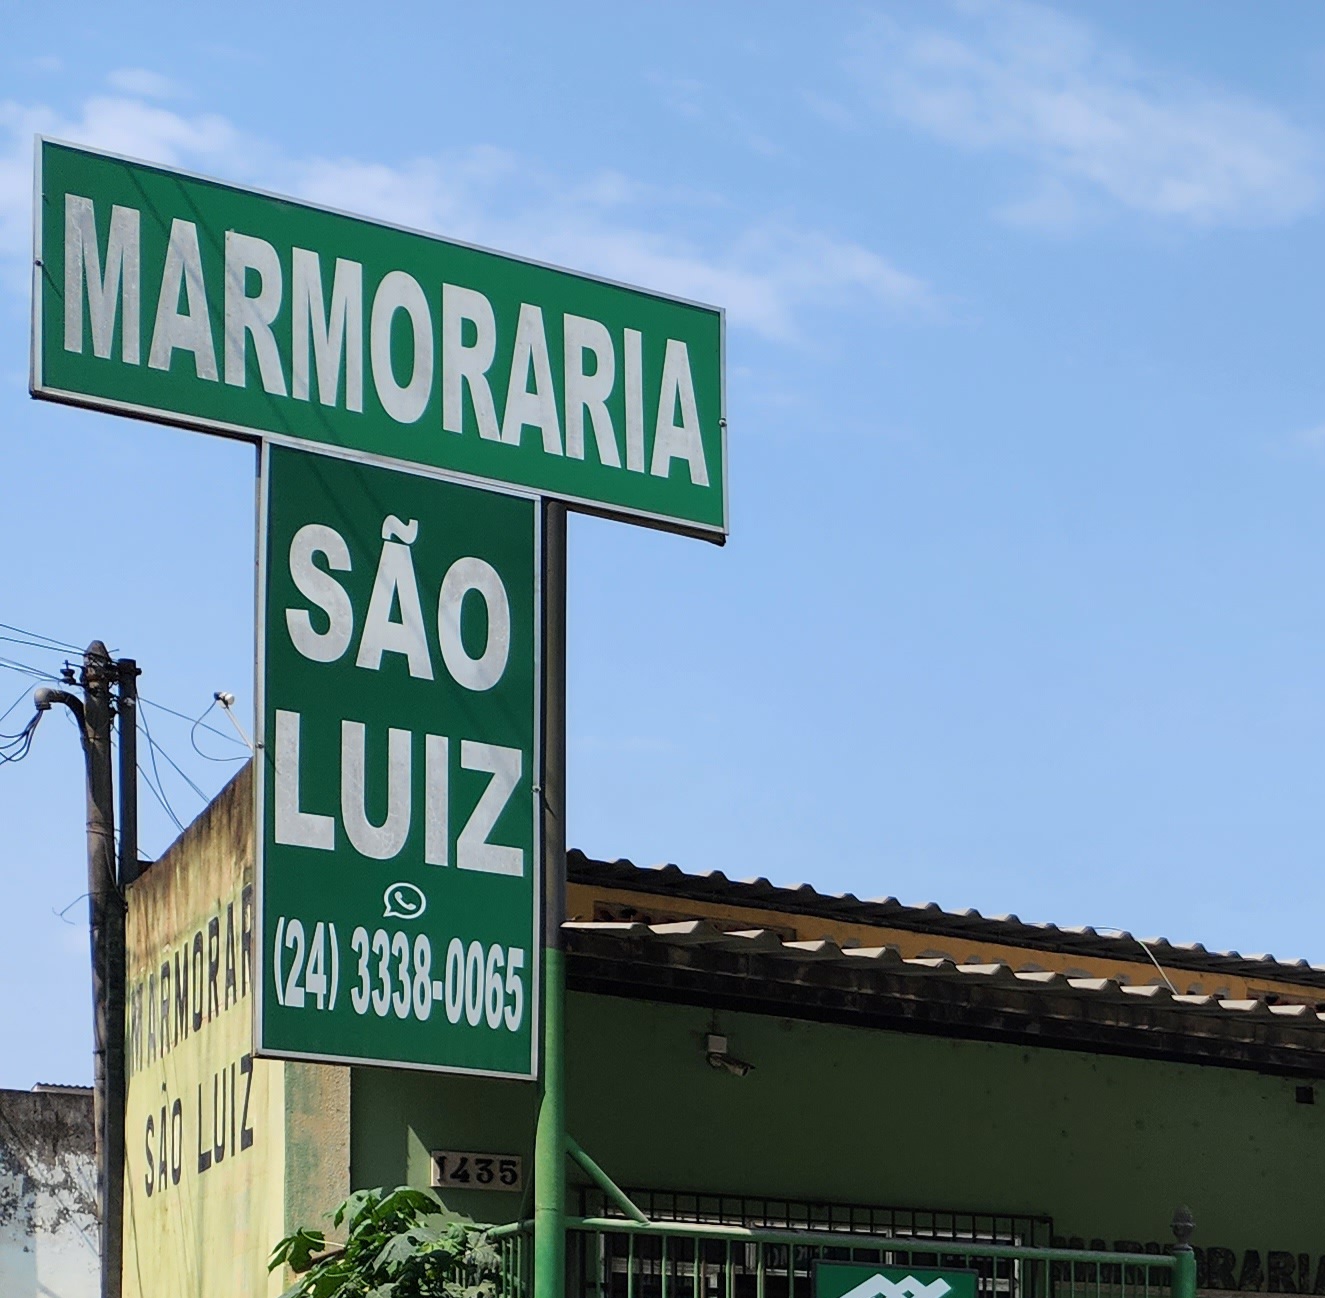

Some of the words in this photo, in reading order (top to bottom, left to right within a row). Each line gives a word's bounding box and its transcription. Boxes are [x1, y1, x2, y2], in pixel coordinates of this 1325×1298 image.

[64, 194, 709, 486] MARMORARIA
[286, 515, 510, 691] SÃO
[274, 710, 523, 876] LUIZ
[273, 917, 337, 1010] (24)
[351, 926, 524, 1032] 3338-0065
[145, 1082, 182, 1197] SÃO
[198, 1053, 253, 1174] LUIZ
[437, 1156, 517, 1185] 1435
